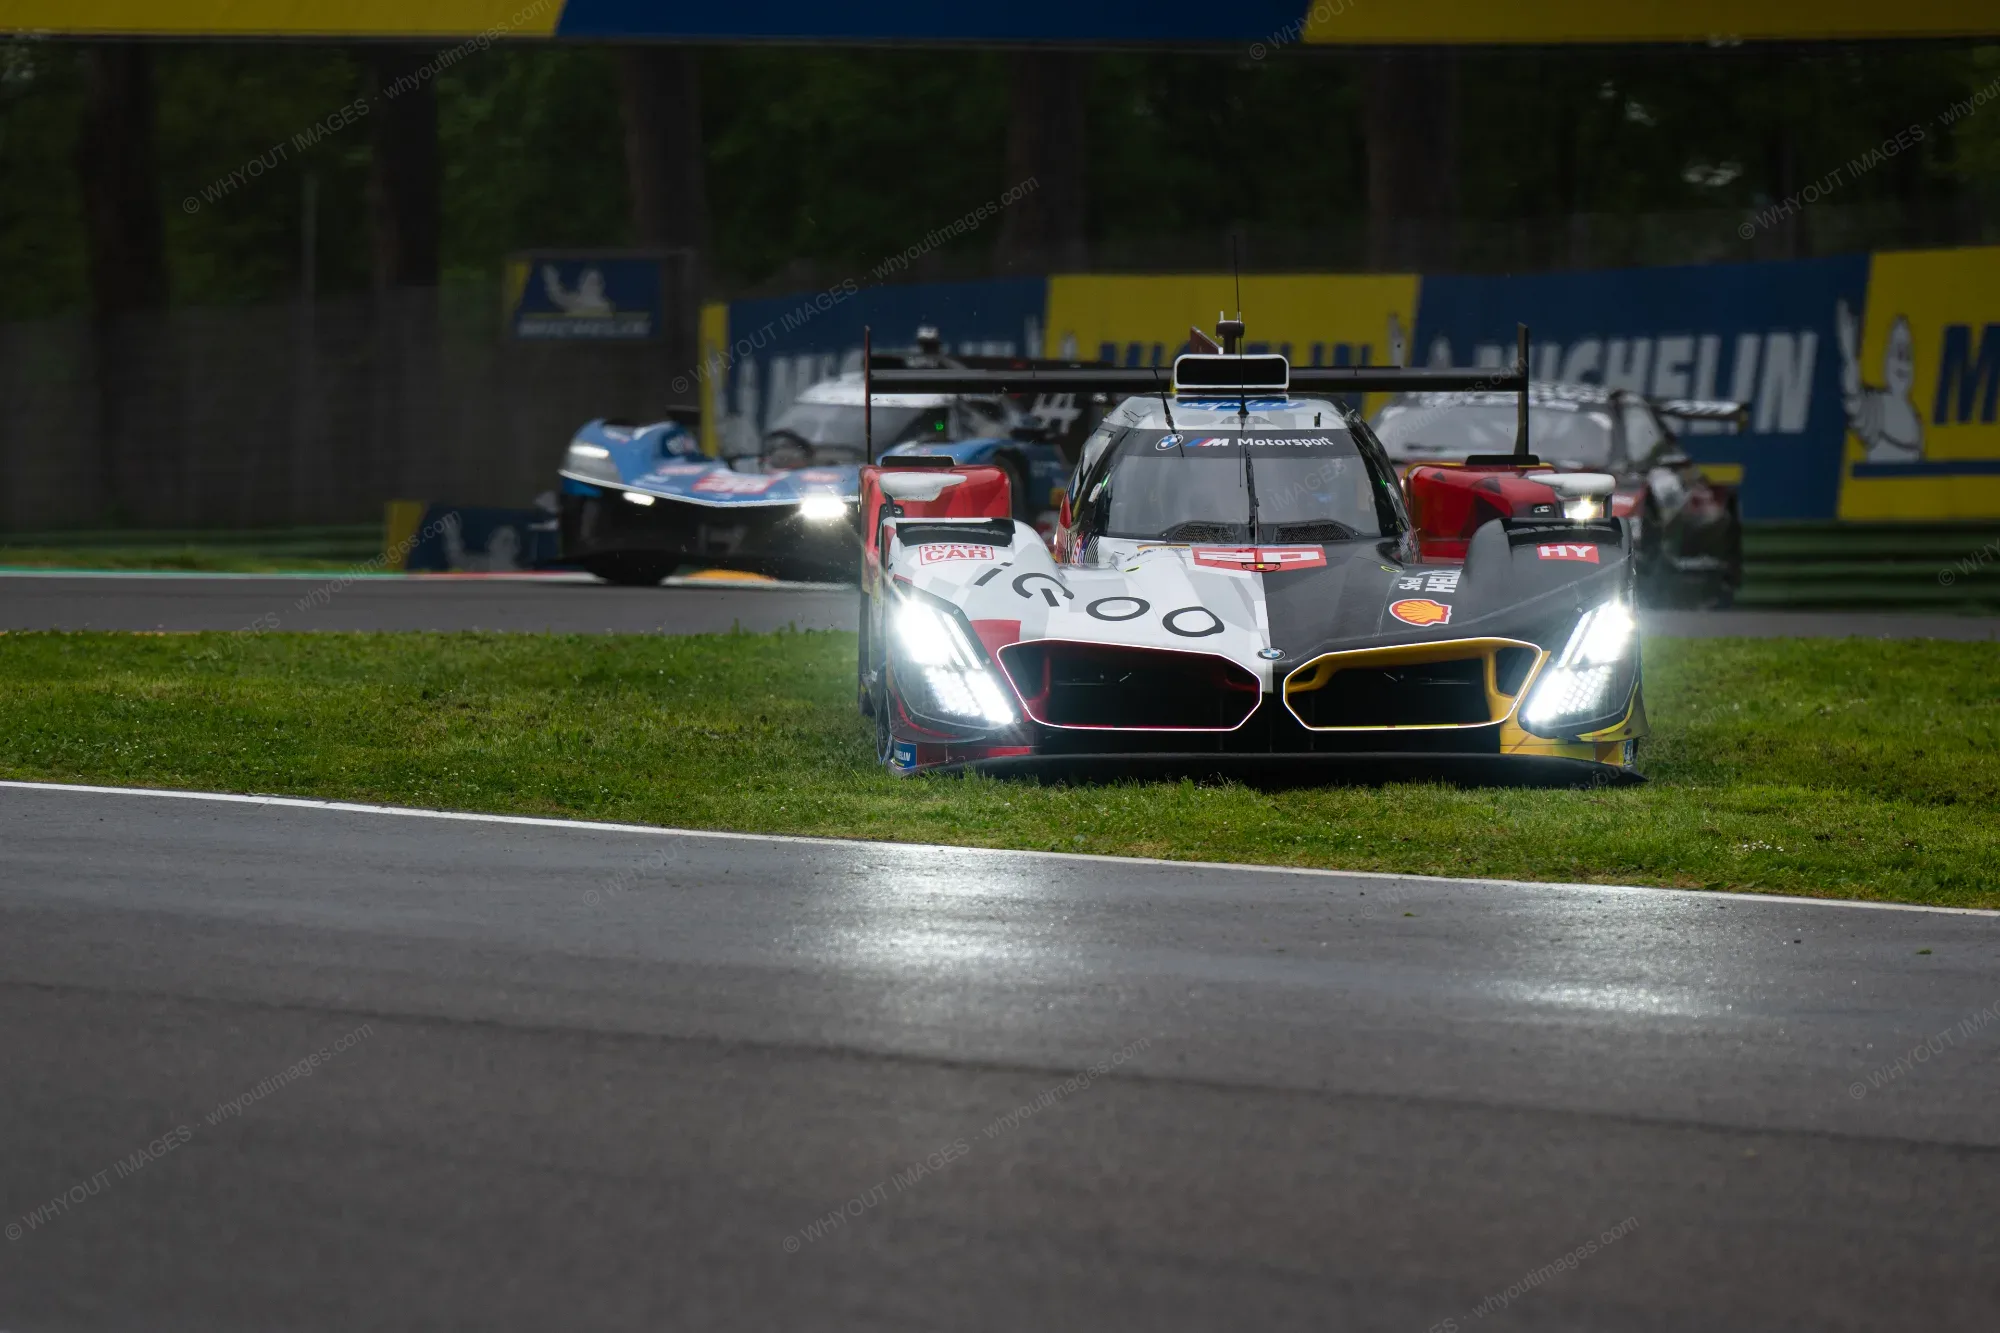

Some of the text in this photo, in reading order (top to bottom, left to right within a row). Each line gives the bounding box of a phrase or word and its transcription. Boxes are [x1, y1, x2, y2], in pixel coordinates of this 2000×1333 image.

[1237, 435, 1334, 448] Motorsport
[925, 550, 988, 562] CAR
[1540, 544, 1592, 558] HY
